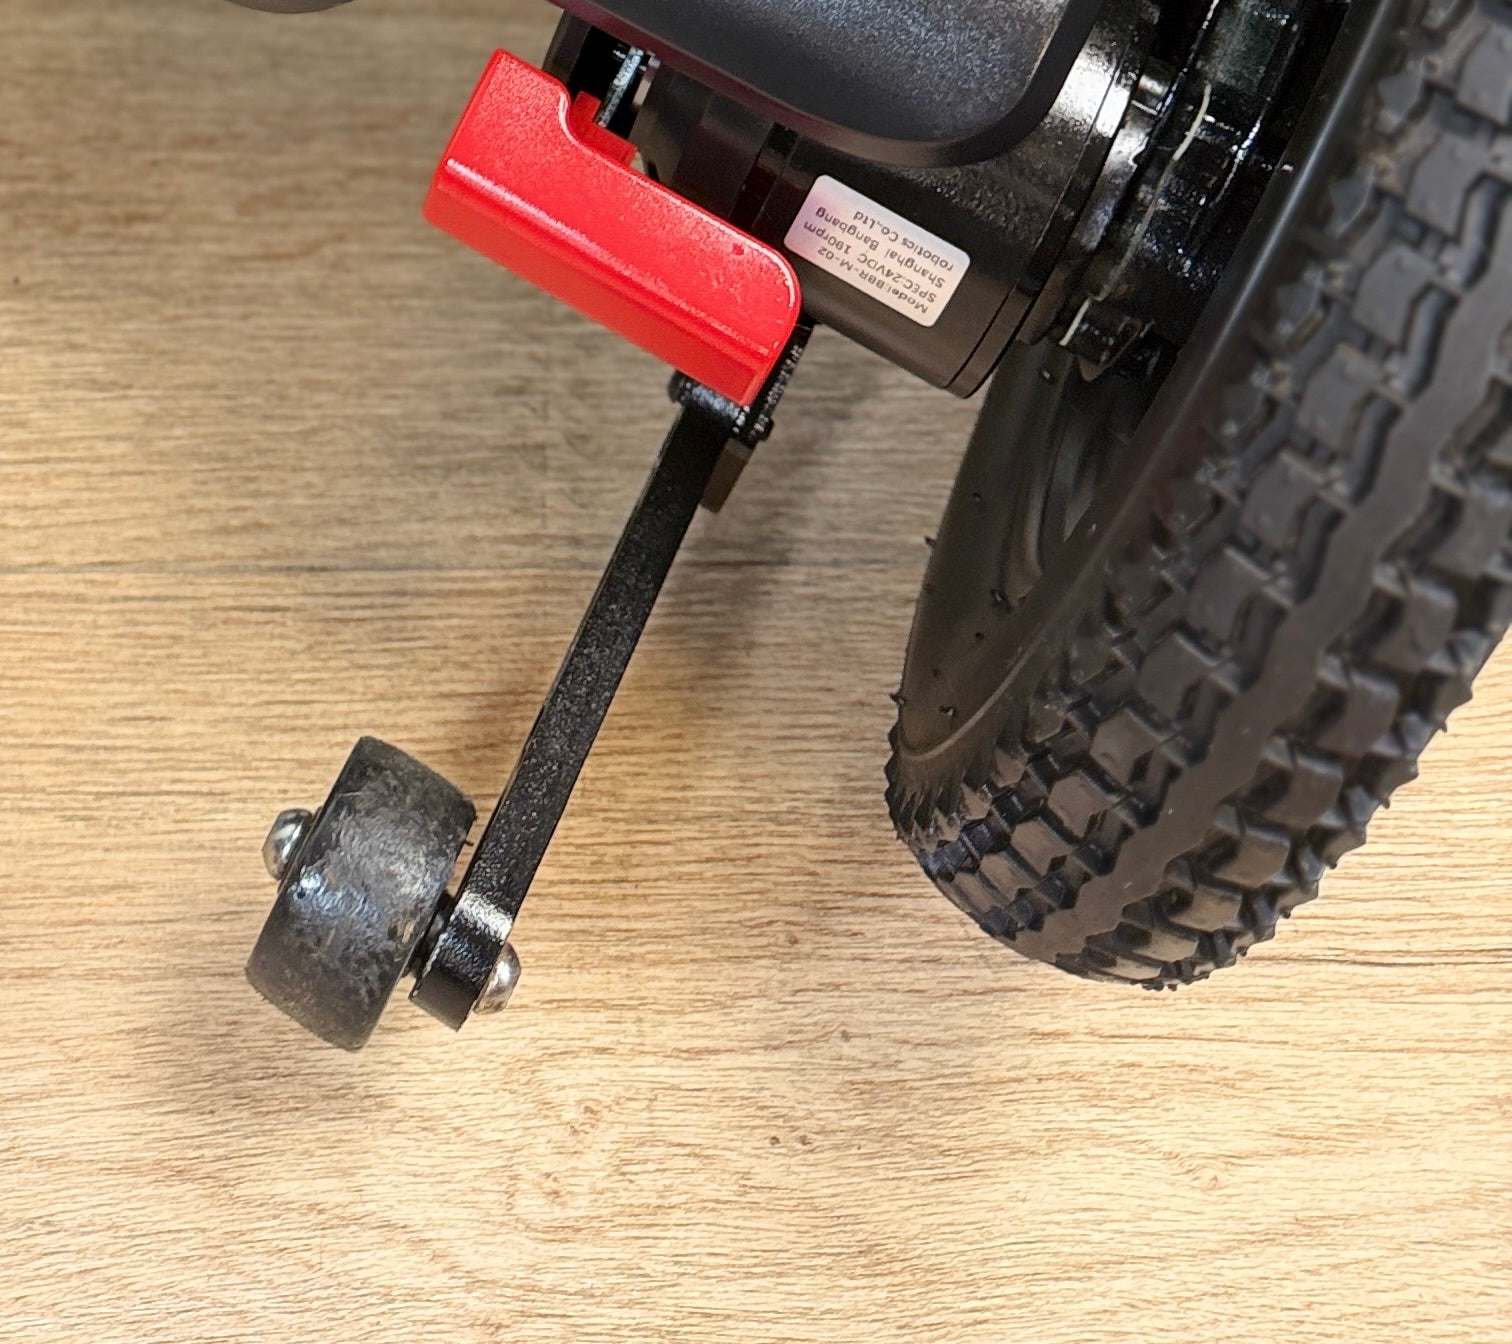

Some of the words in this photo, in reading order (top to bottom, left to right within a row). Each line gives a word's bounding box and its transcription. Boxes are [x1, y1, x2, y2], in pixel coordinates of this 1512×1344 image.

[814, 206, 881, 252] Bangbang
[884, 246, 946, 289] Shanghai
[899, 237, 954, 274] robotics
